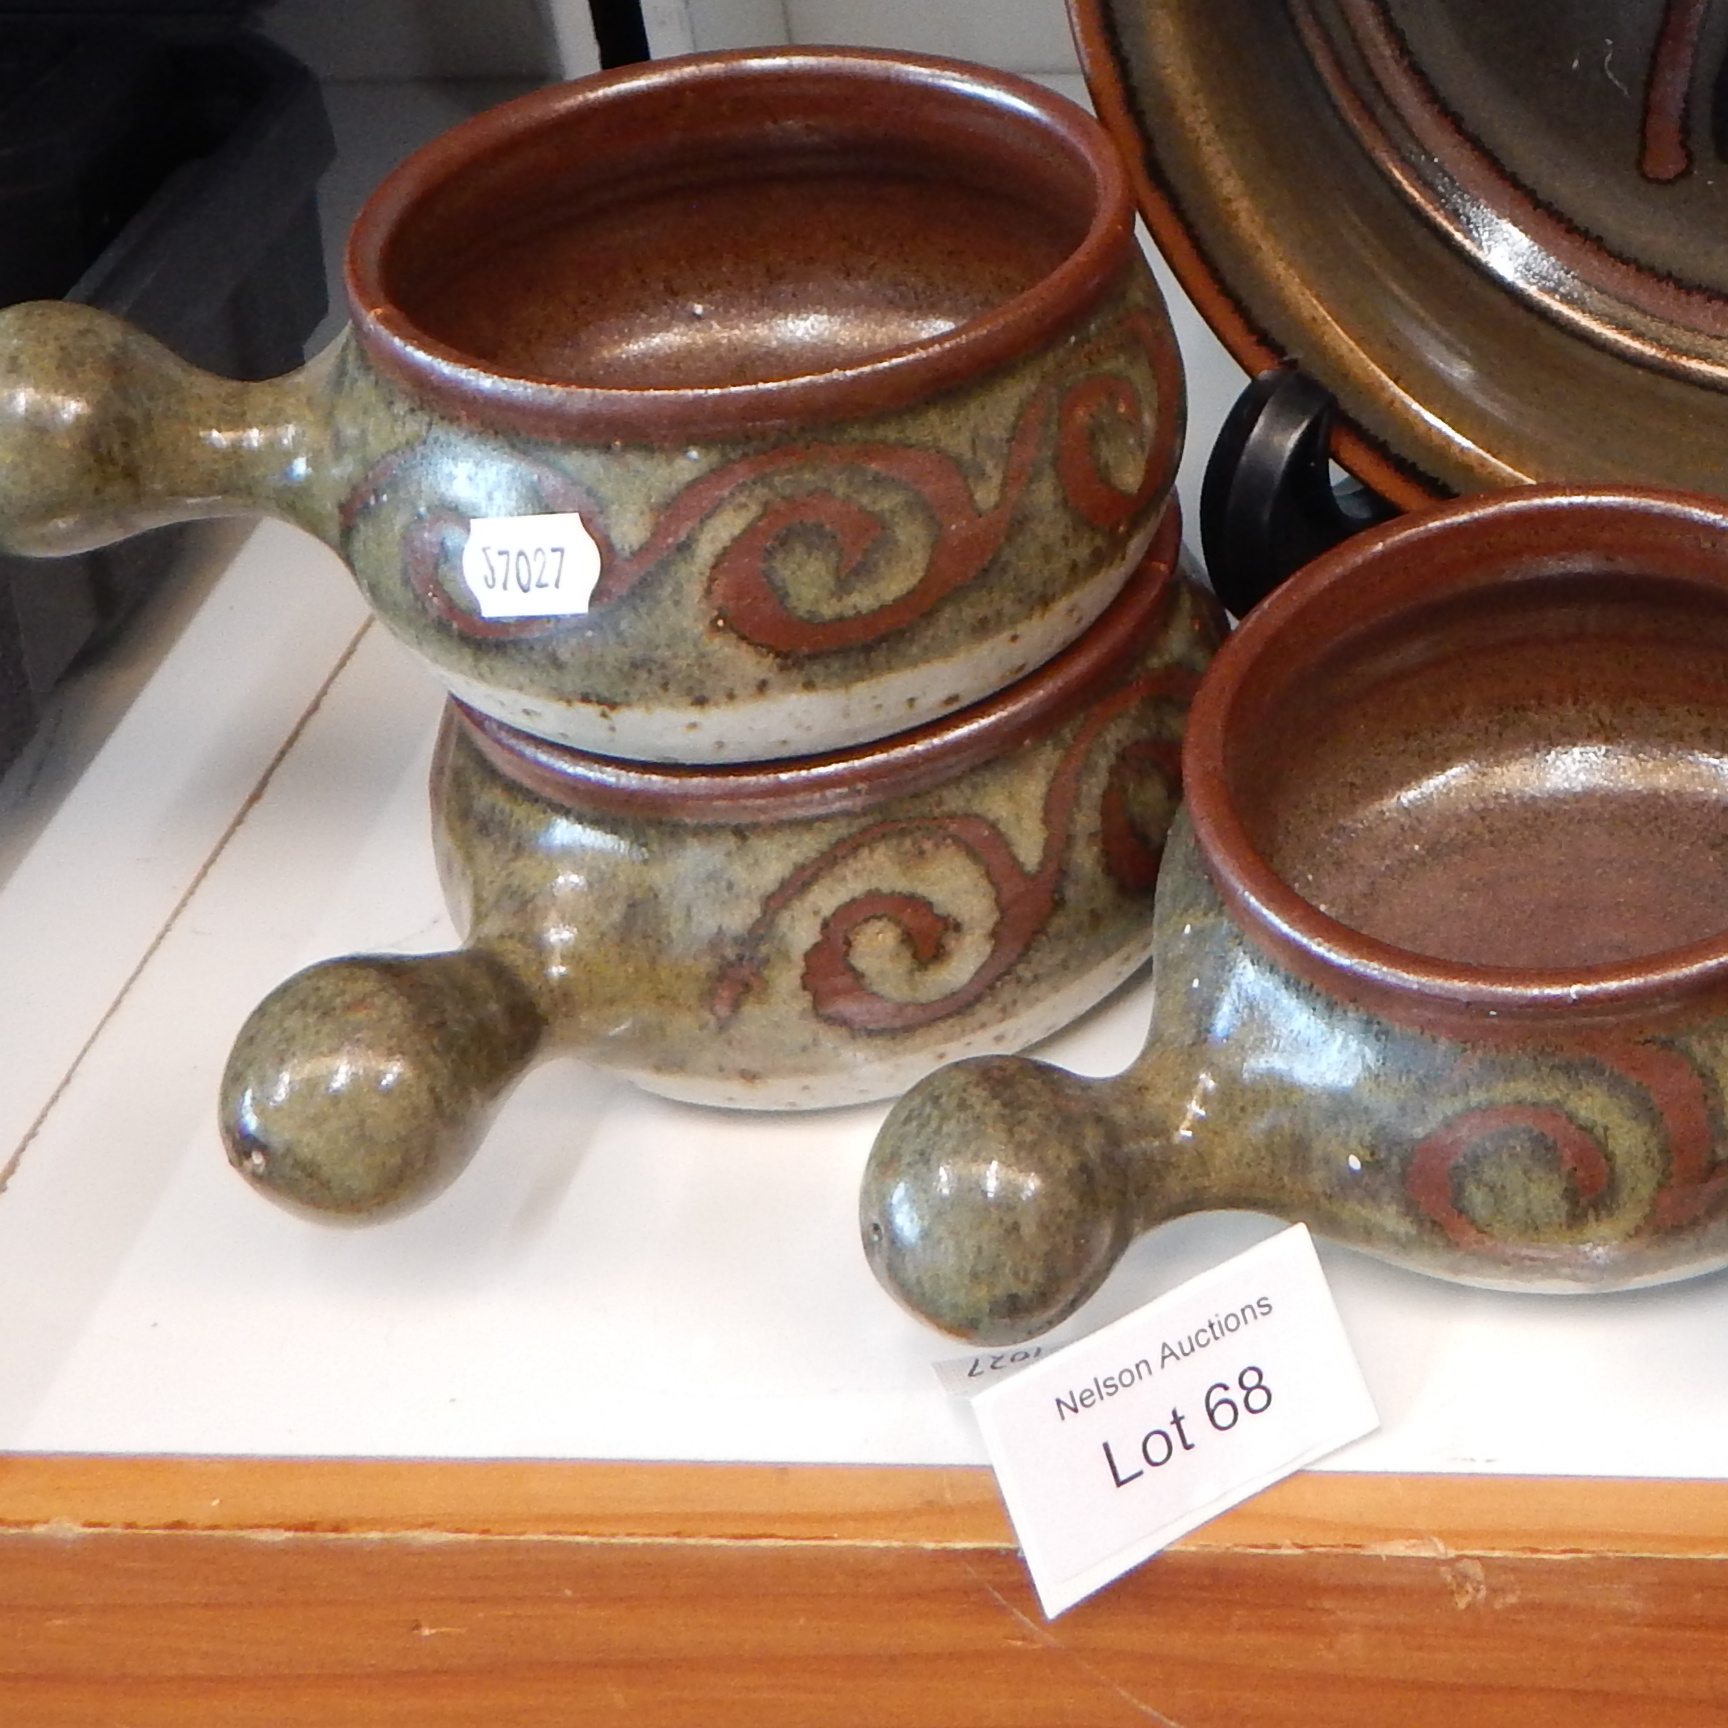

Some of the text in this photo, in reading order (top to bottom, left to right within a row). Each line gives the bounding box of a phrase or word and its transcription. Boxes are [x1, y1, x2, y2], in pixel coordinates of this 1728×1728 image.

[1055, 1295, 1273, 1421] Nelson Auctions
[1102, 1365, 1273, 1487] Lot 68
